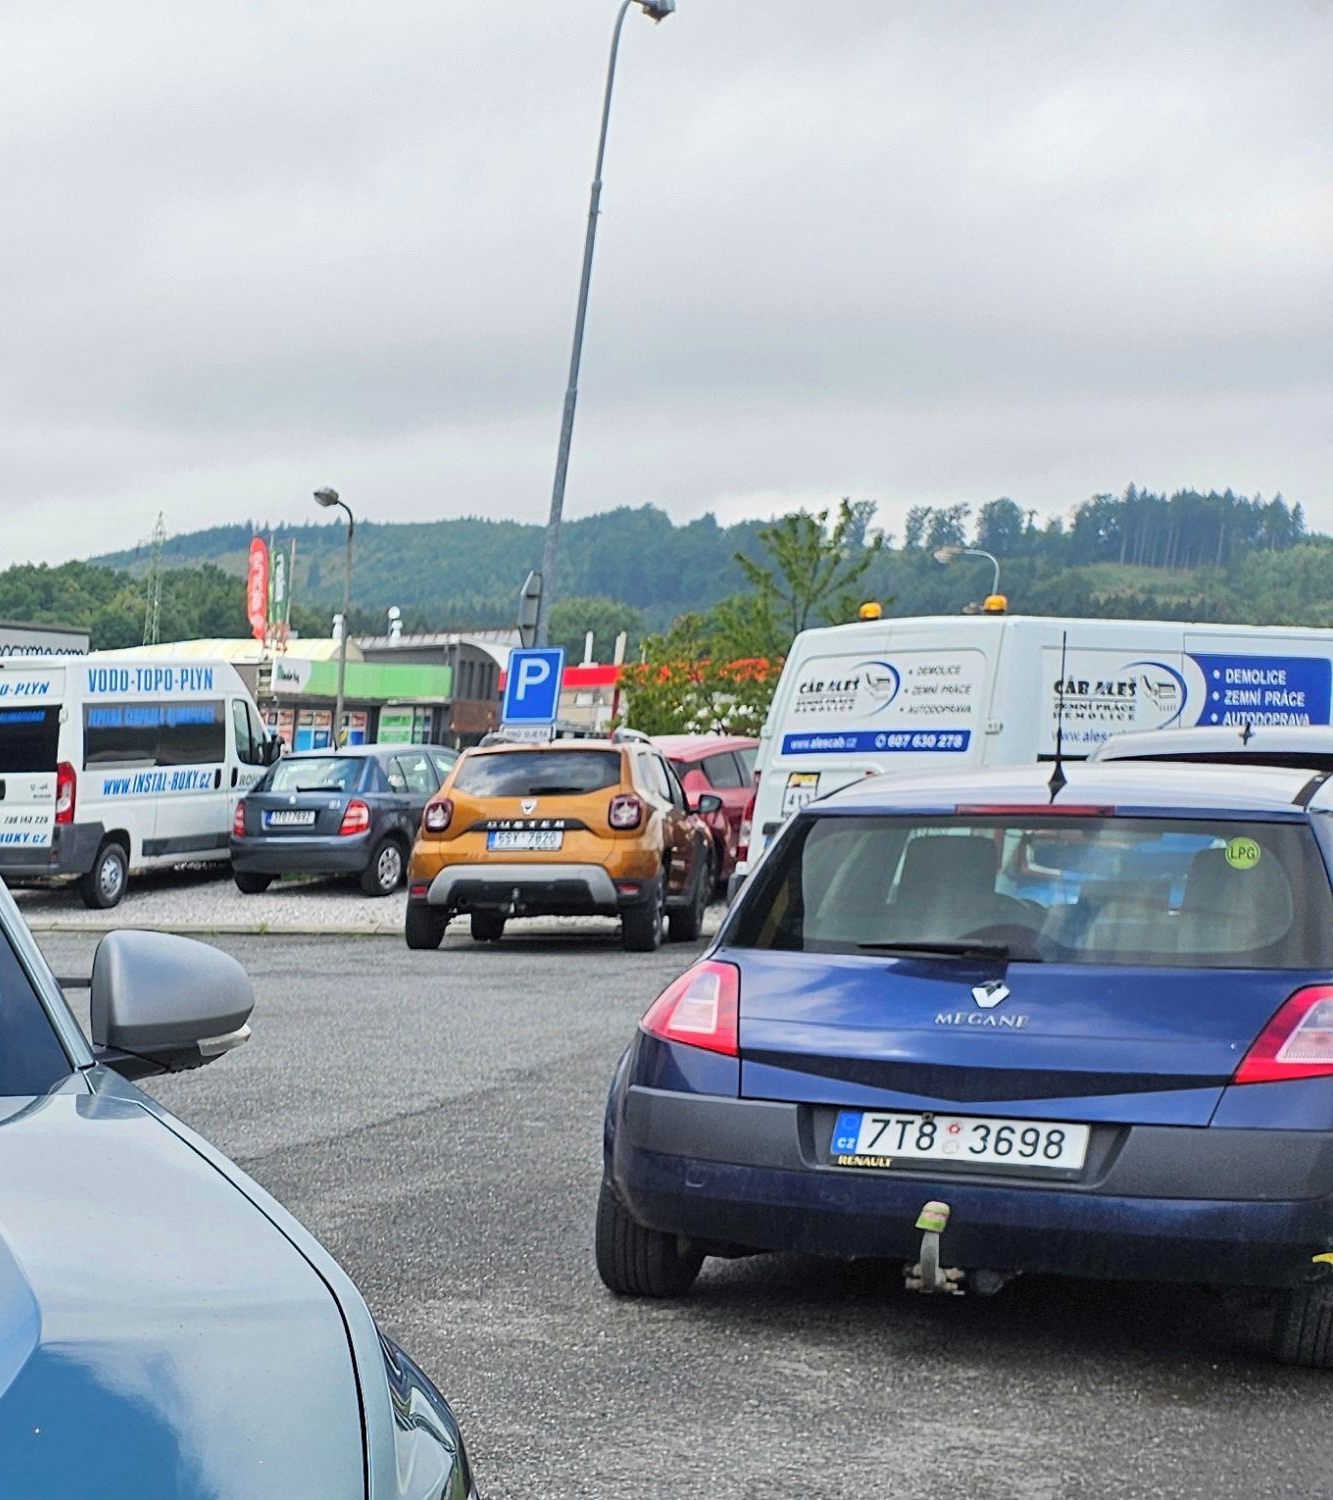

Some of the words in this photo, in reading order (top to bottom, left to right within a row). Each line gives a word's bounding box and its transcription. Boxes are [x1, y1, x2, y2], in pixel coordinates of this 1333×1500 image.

[516, 658, 550, 700] P
[1225, 668, 1286, 685] DEMOLICE
[1095, 676, 1137, 697] ALEŠ
[1223, 689, 1261, 706] ZEMNÍ
[1265, 689, 1305, 708] PRÁCE
[1223, 711, 1311, 726] AUTODOPRAVA
[1228, 843, 1256, 860] LPG
[836, 1137, 856, 1150] CZ
[867, 1117, 937, 1151] 7T8
[968, 1124, 1067, 1160] 3698
[837, 1155, 893, 1168] RENAULT
